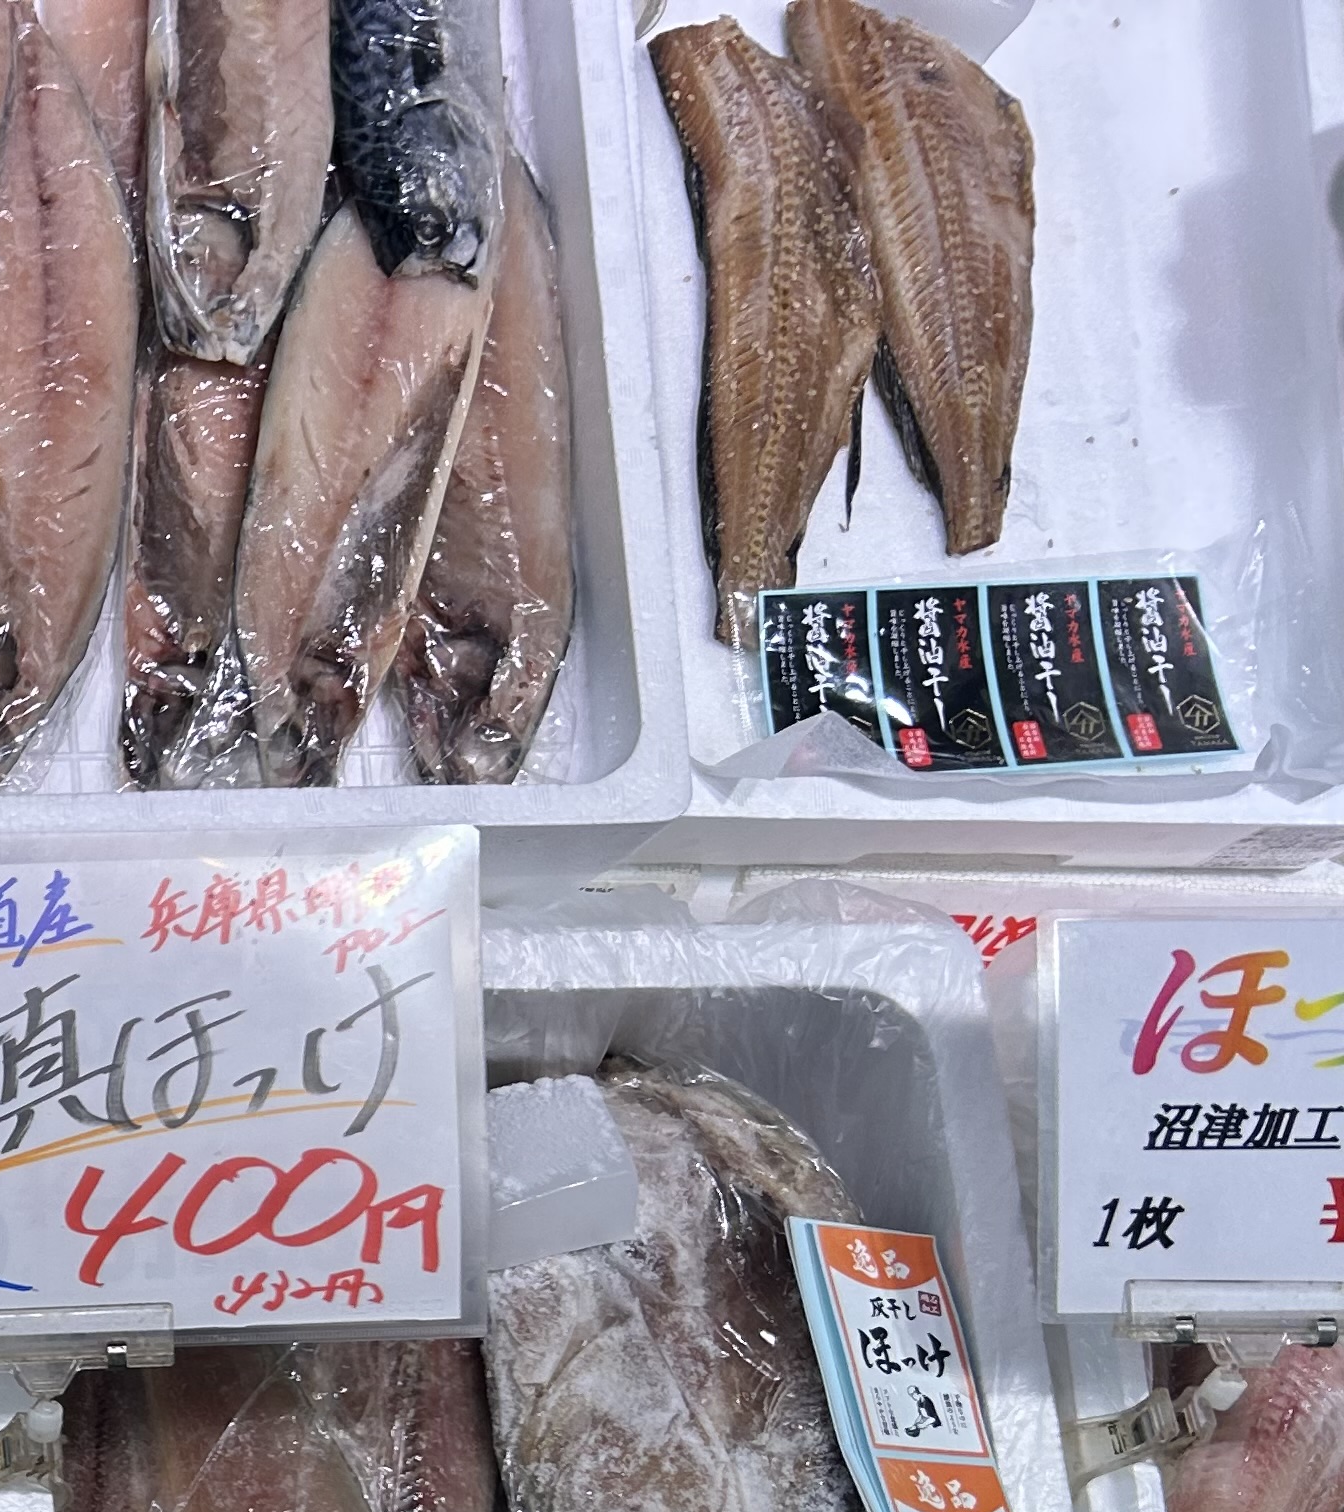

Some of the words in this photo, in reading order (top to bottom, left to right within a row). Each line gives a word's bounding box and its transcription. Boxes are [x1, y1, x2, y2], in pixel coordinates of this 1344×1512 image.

[953, 598, 973, 670] ヤマカ水産
[64, 1148, 445, 1287] 400円
[1092, 1197, 1186, 1250] 1枚
[869, 1296, 917, 1321] 灰干し
[858, 1326, 952, 1378] ほっけ
